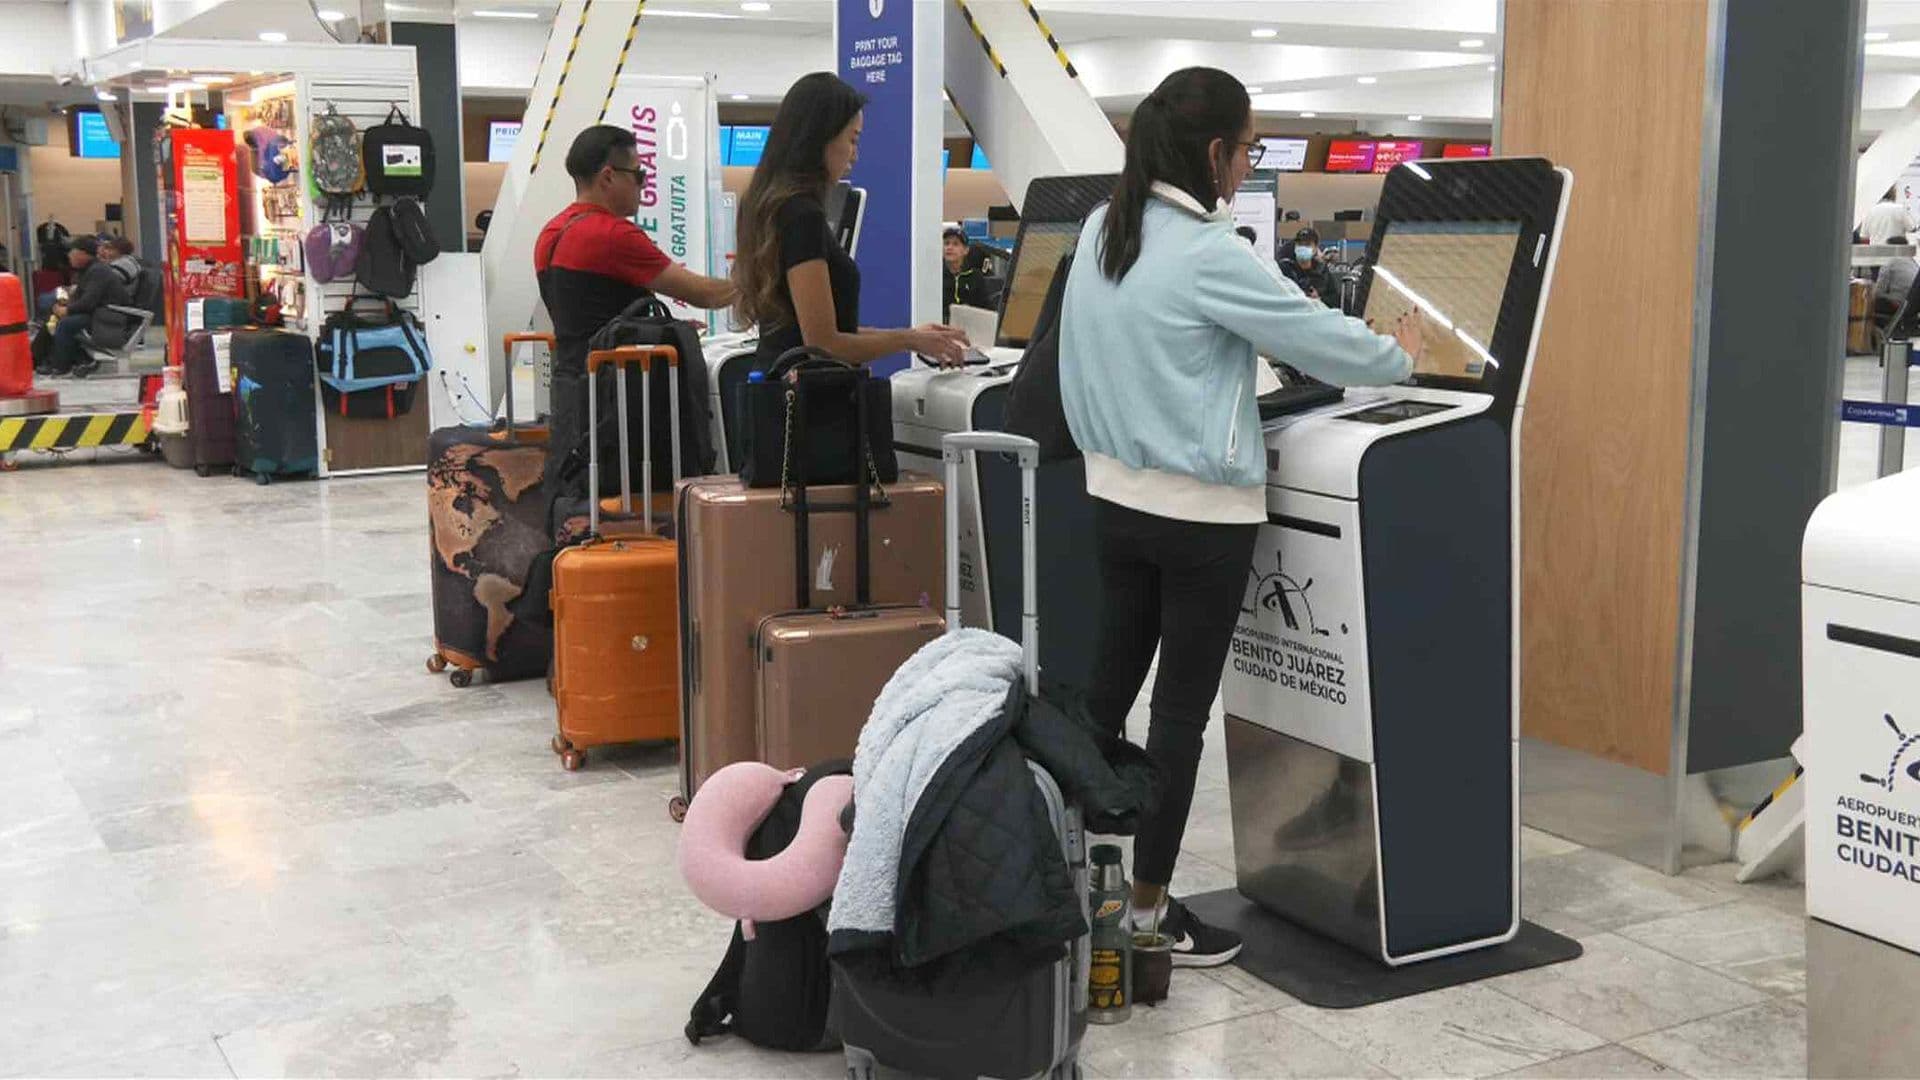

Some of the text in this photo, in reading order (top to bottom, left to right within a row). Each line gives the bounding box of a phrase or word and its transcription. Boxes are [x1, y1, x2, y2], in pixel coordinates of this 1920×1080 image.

[855, 36, 898, 53] PRINT YOUR
[850, 51, 902, 69] BAGGAGE TAG
[866, 69, 886, 83] HERE
[736, 131, 763, 140] MAIN
[671, 173, 687, 258] GRATUITA
[1231, 637, 1346, 687] BENITO JUÁREZ
[1281, 637, 1345, 665] INTERNACIONAL
[1233, 658, 1347, 705] CIUDAD DE MÉXICO
